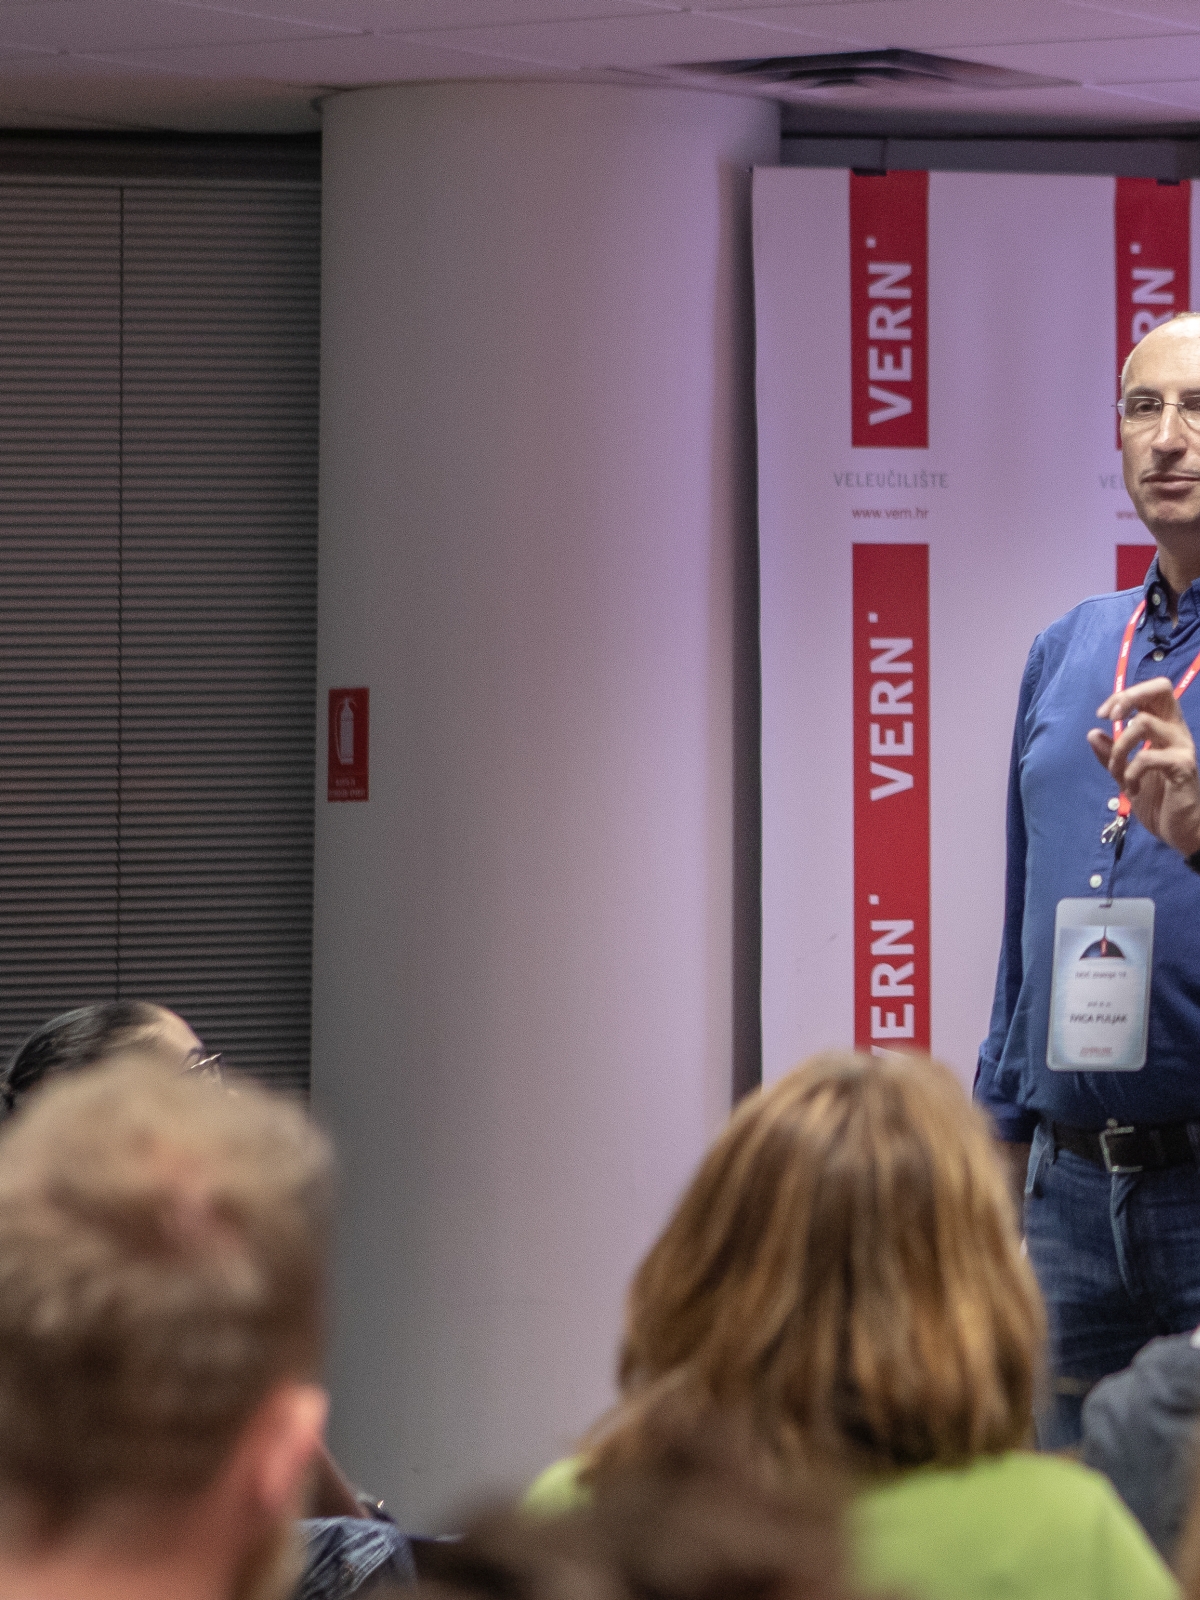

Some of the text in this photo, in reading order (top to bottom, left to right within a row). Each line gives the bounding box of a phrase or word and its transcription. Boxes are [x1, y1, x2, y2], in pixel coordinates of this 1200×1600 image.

[1131, 267, 1175, 344] RN
[833, 469, 949, 489] VELEUČILIŠTE
[870, 919, 915, 1058] ERN
